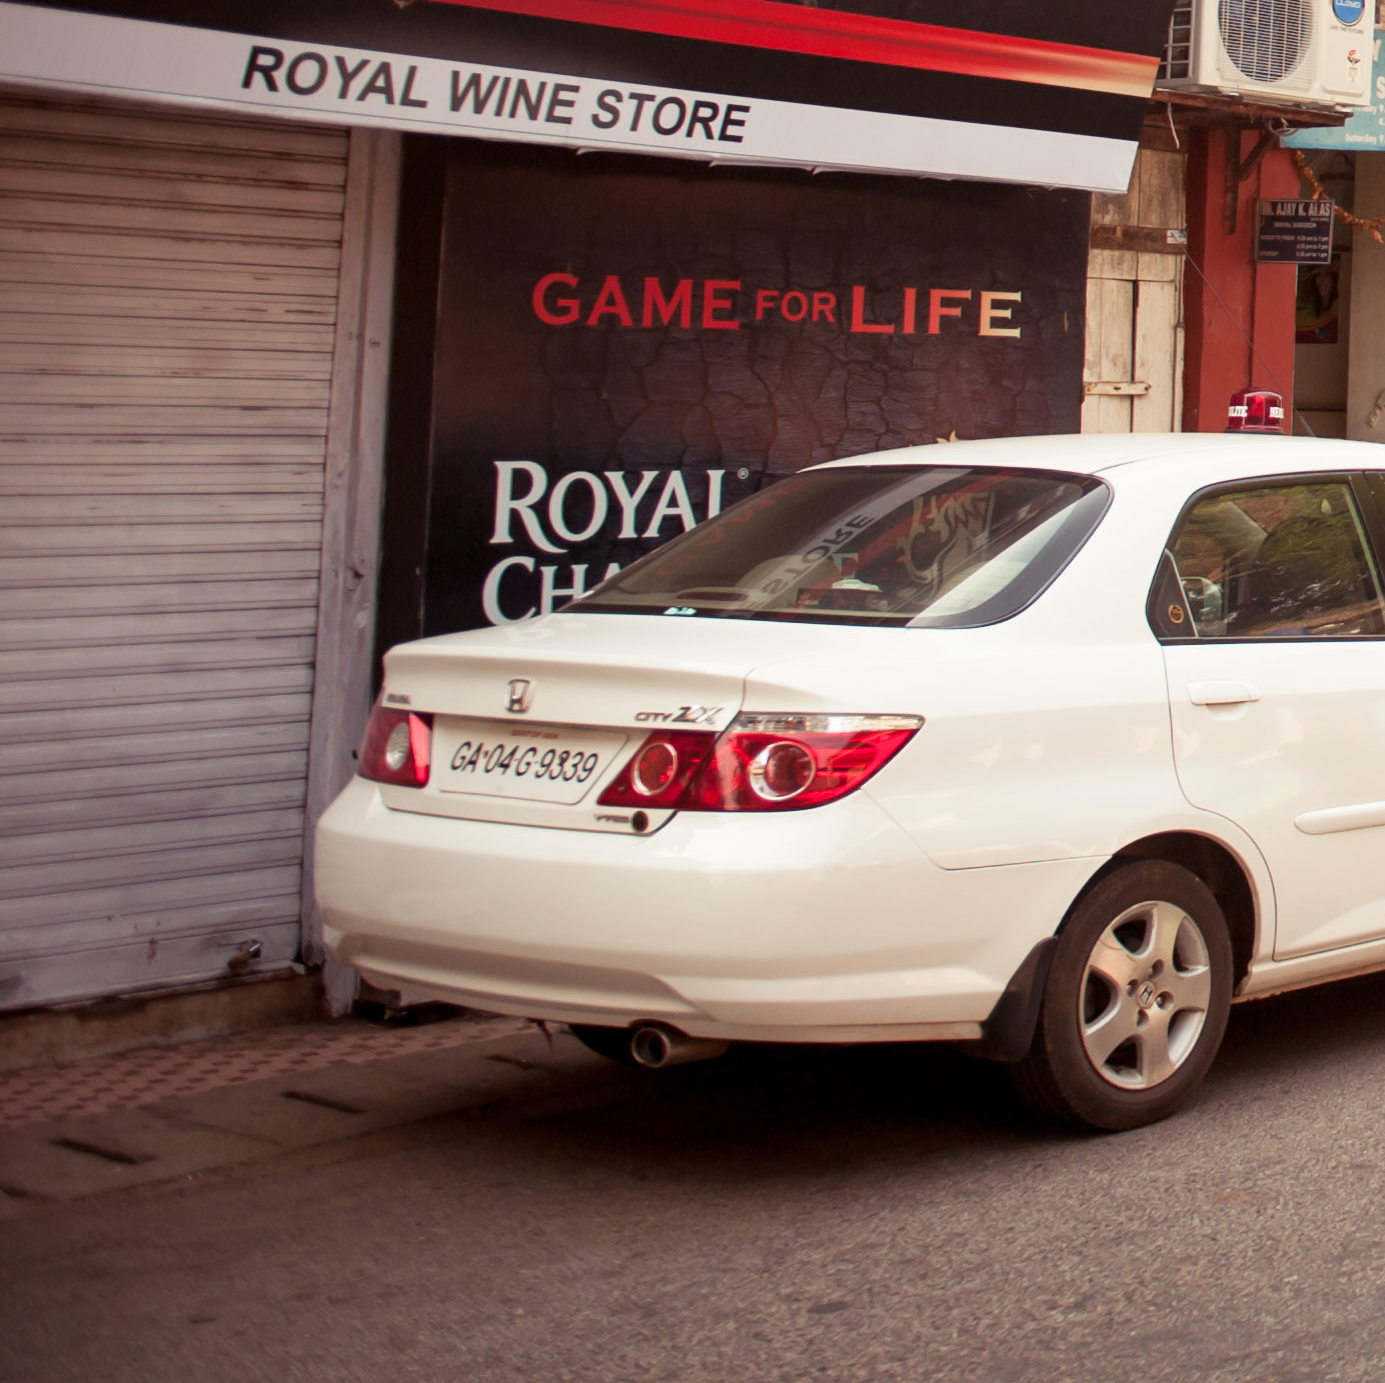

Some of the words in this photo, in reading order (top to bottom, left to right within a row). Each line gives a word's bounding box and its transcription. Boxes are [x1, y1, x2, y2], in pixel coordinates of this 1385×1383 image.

[241, 46, 429, 107] ROYAL
[449, 69, 581, 125] WINE
[591, 88, 751, 143] STORE
[532, 273, 742, 331] GAME
[755, 289, 836, 324] FOR
[849, 285, 1022, 339] LIFE
